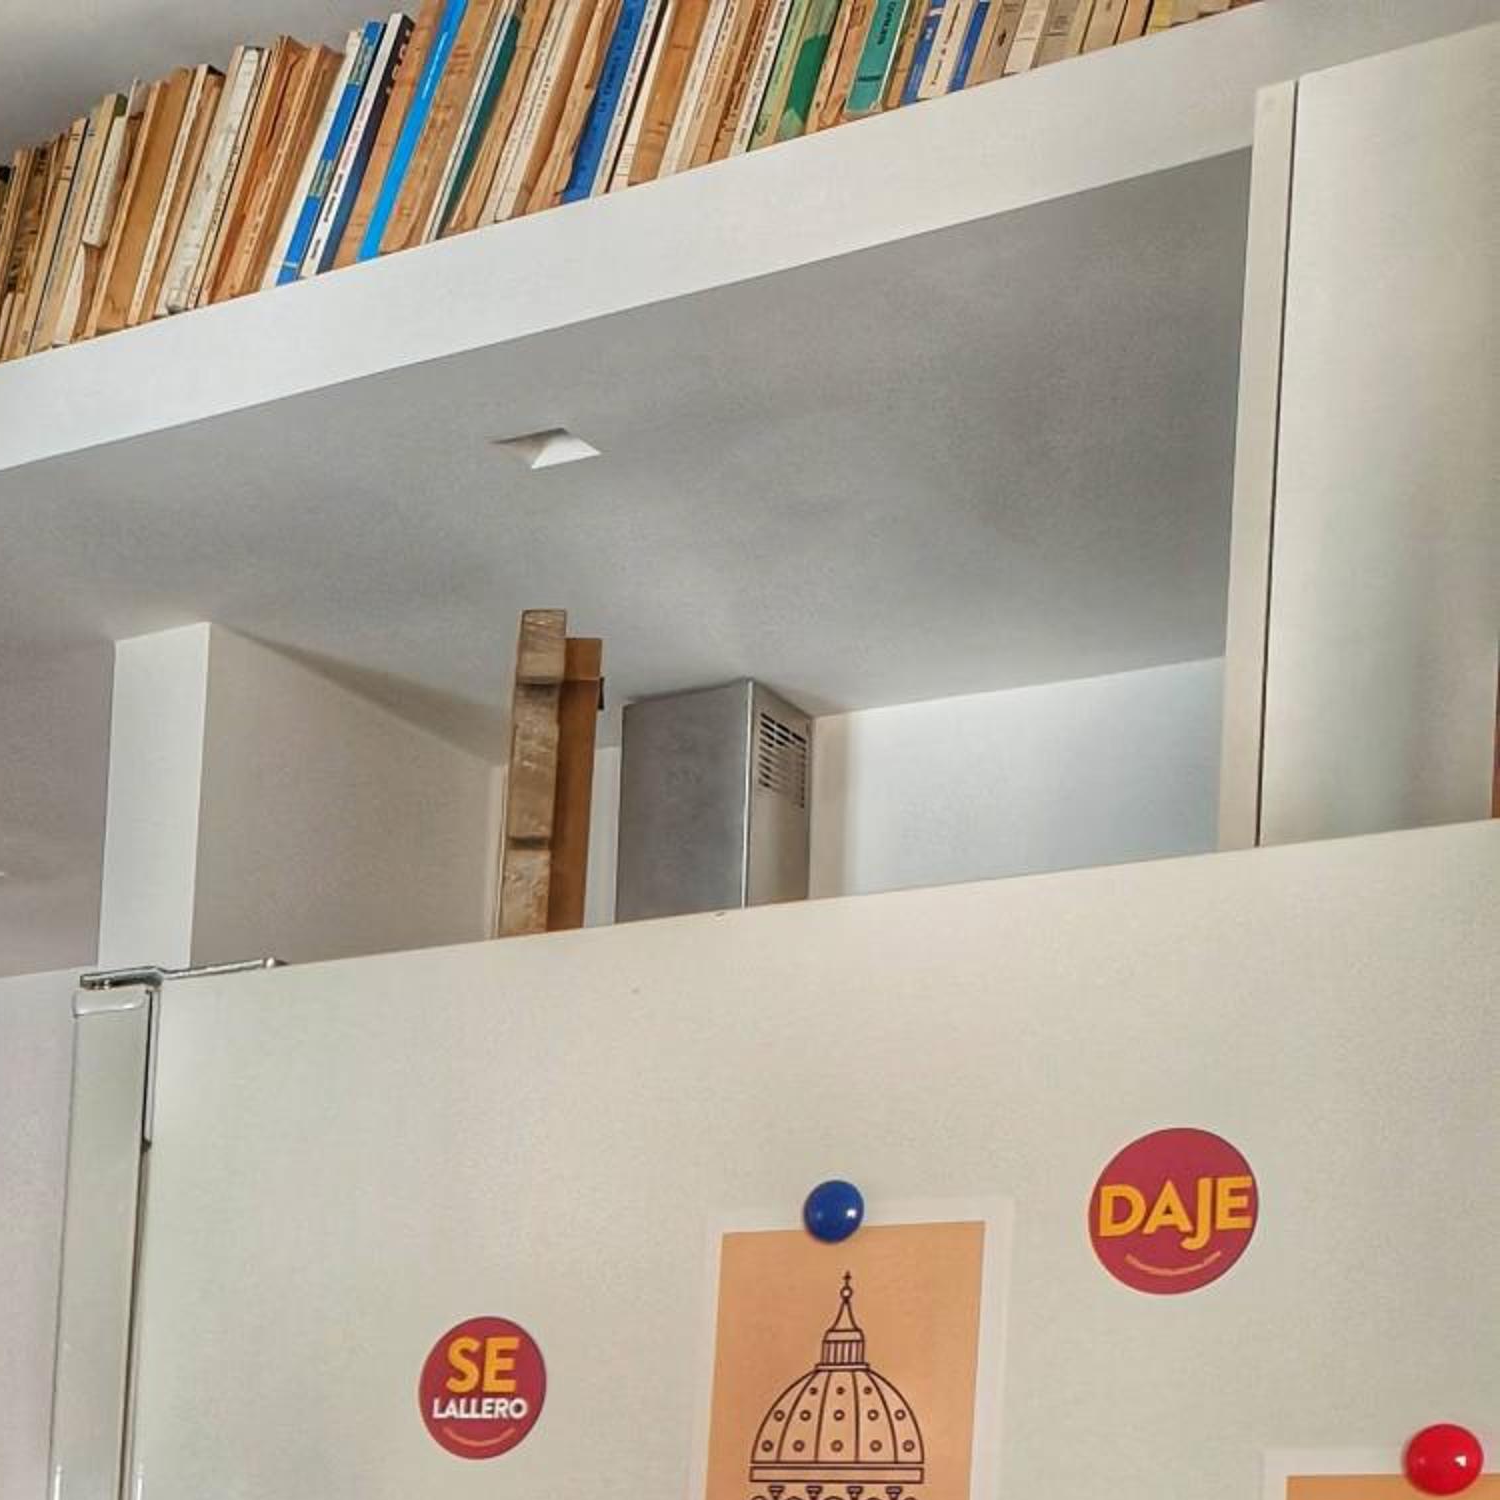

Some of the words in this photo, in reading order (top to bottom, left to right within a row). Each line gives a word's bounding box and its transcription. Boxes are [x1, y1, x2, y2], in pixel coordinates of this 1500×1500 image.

[1099, 1175, 1253, 1250] DAJE
[446, 1336, 520, 1393] SE
[432, 1397, 528, 1420] LALLERO
